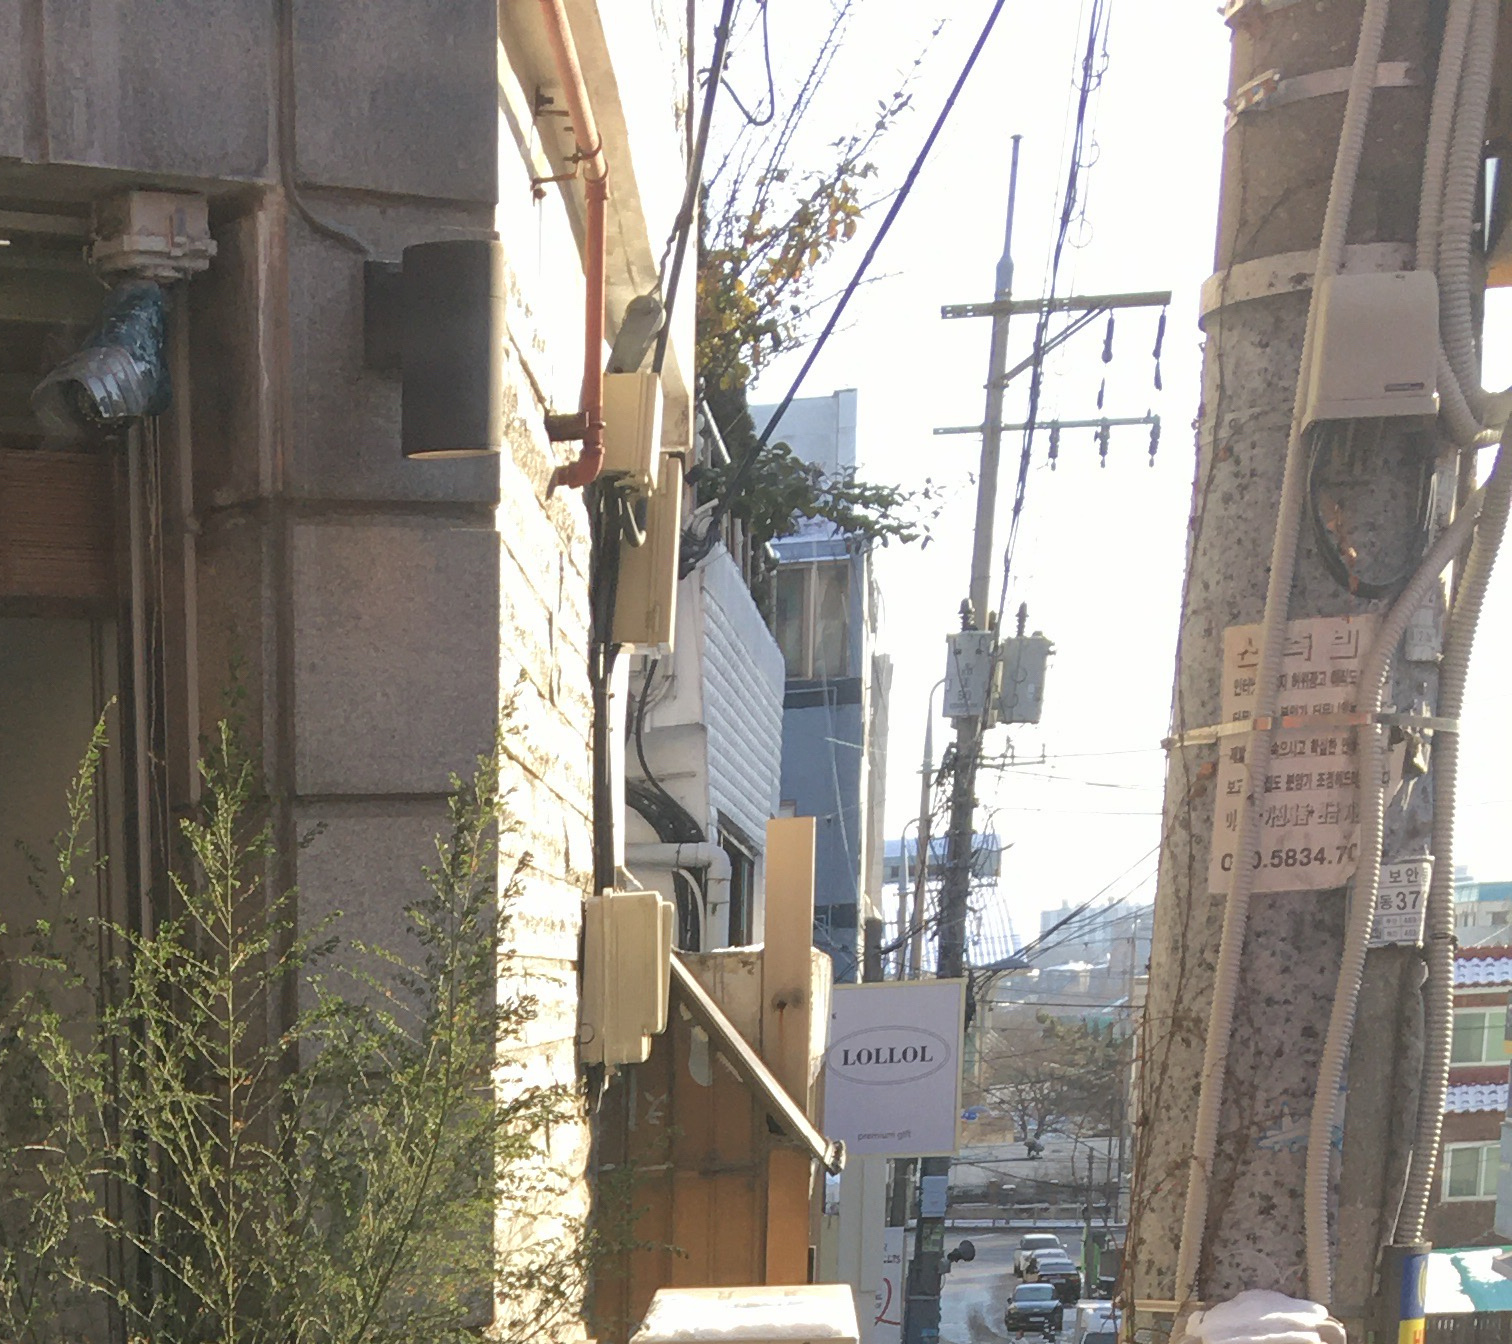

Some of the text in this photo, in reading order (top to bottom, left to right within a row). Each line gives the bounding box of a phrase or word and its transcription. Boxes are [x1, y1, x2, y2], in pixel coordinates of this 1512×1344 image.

[1388, 867, 1419, 884] 보안
[842, 1045, 934, 1066] LOLLOL
[857, 1129, 911, 1142] premium gift
